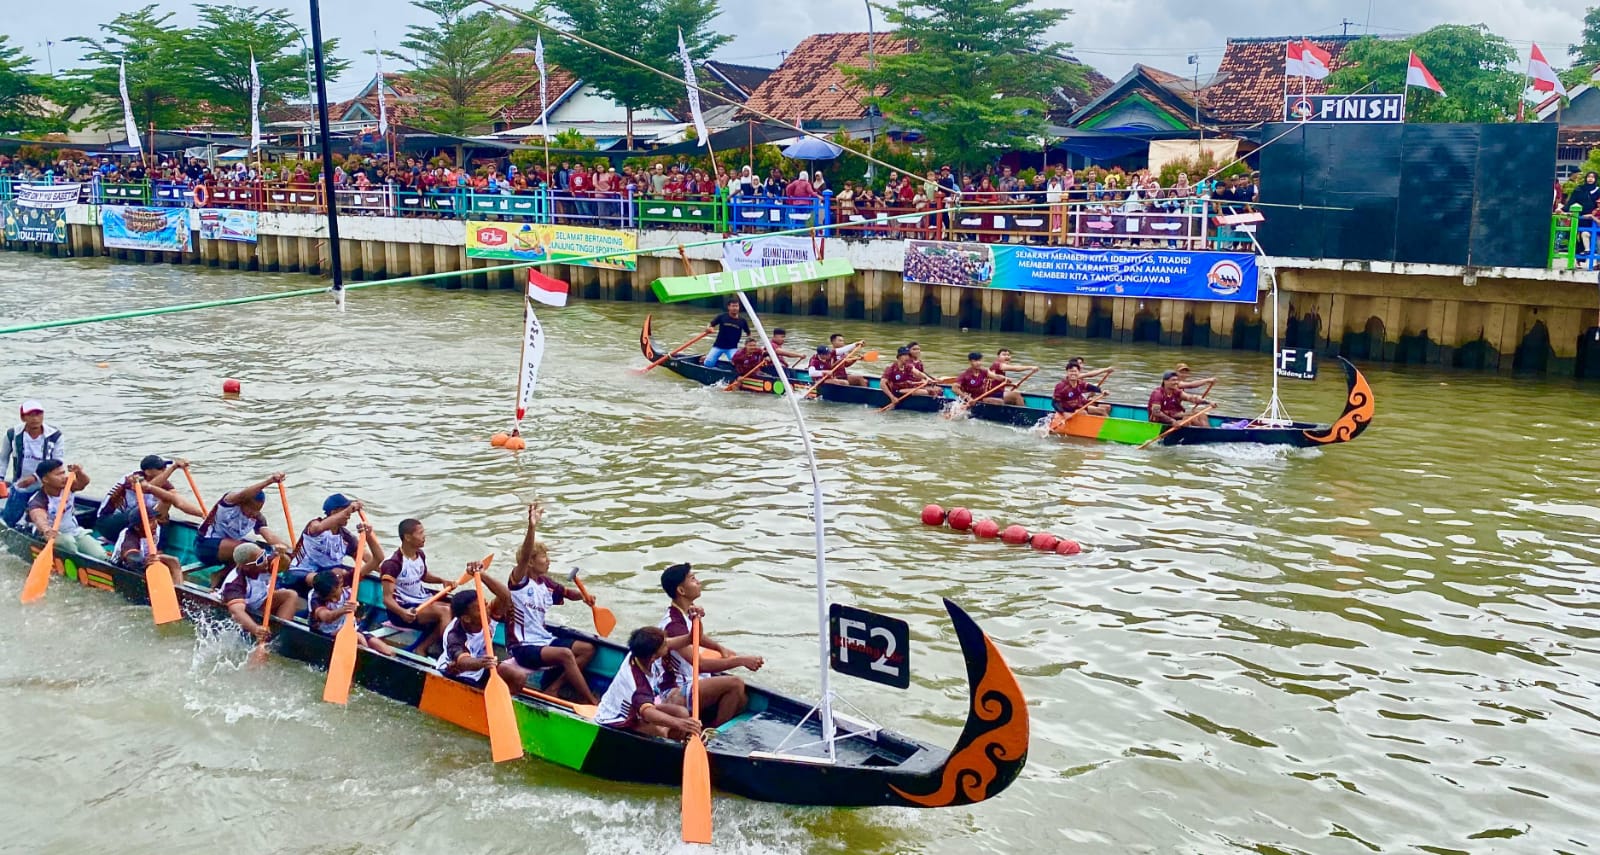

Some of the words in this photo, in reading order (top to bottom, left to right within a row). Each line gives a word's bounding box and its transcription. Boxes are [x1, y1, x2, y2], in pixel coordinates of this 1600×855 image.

[1321, 99, 1399, 119] FINISH
[555, 231, 583, 241] SELAMAT
[584, 234, 624, 246] BERTANDING
[1015, 250, 1049, 260] SEJARAH
[1050, 252, 1088, 262] MEMBERI
[1089, 254, 1109, 263] KITA
[1158, 256, 1192, 265] TRADISI
[1018, 260, 1054, 270] MEMBERI
[1055, 262, 1075, 271] KITA
[1123, 265, 1143, 273] DAN
[1144, 266, 1187, 275] AMANAH
[708, 260, 818, 293] FINISH
[1031, 270, 1068, 280] MEMBERI
[1069, 272, 1089, 281] KITA
[1090, 274, 1171, 284] TANGGUNGJAWAB
[840, 617, 899, 677] F2
